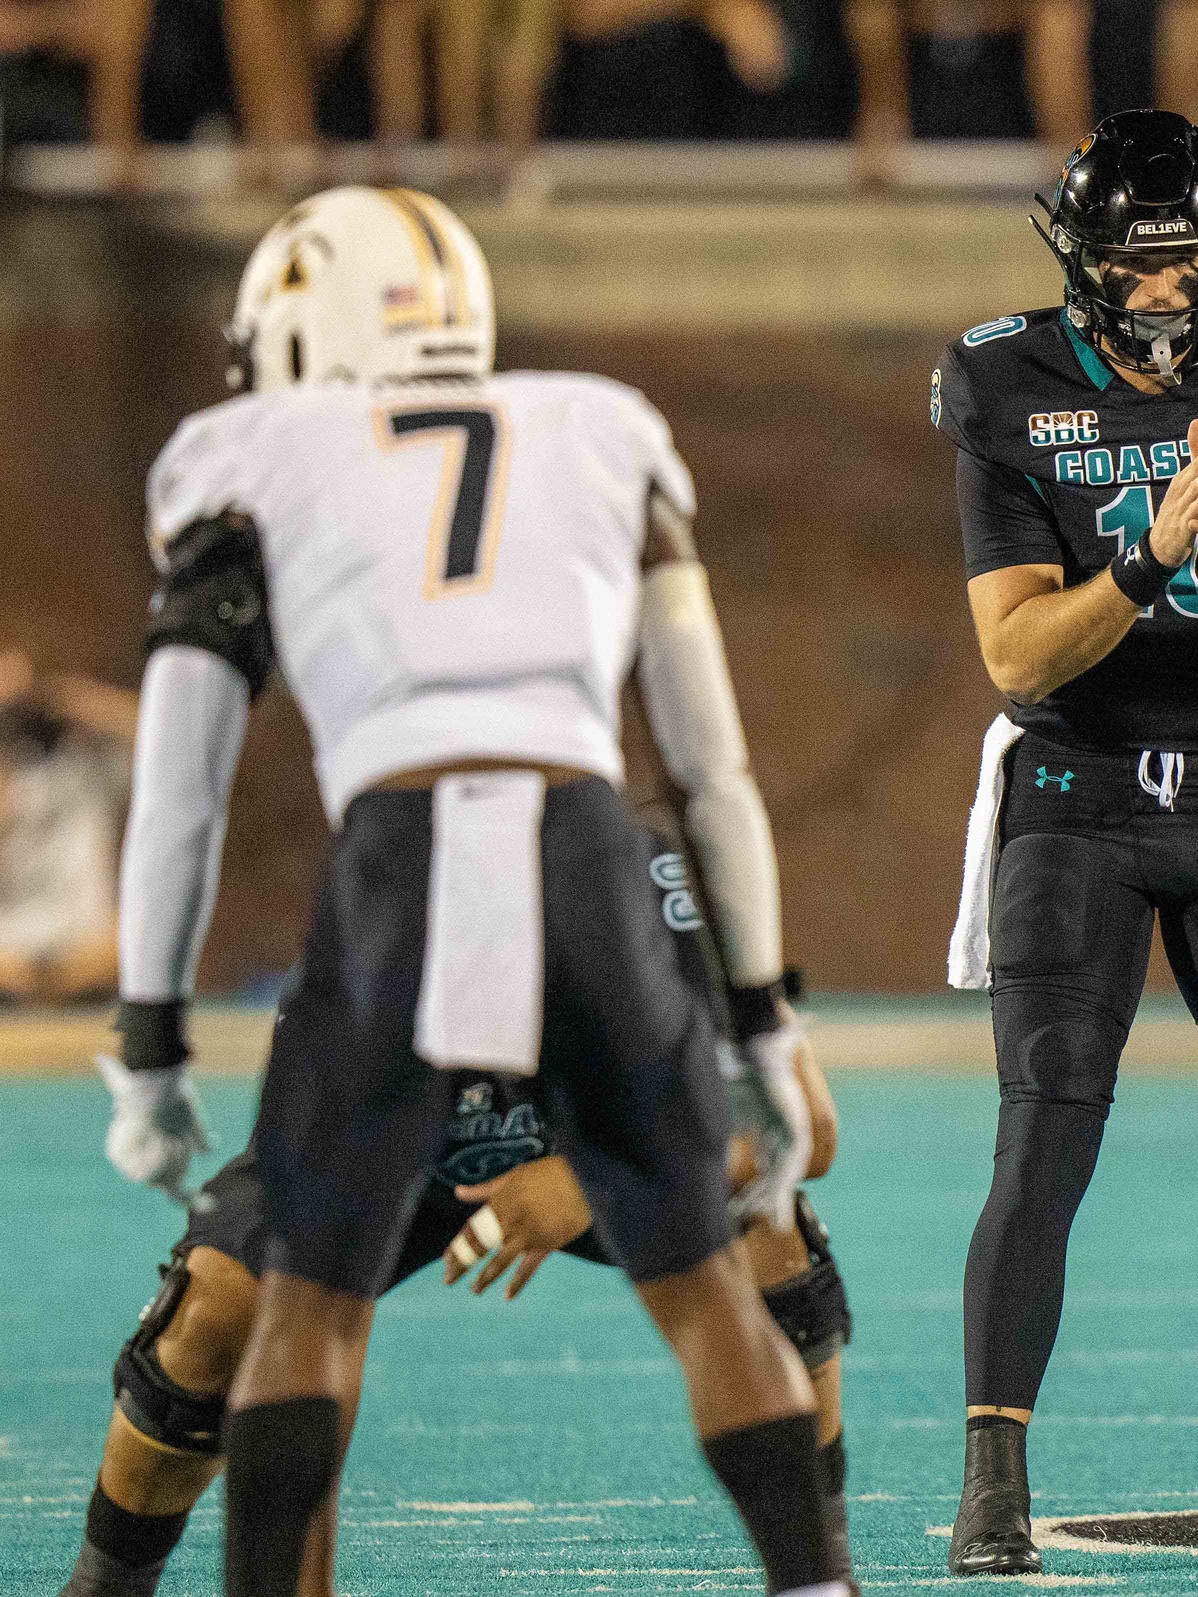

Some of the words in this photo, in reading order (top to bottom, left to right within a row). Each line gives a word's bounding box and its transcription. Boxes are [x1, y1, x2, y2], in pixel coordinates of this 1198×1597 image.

[1137, 222, 1187, 236] BEL1EVE
[961, 316, 1027, 348] 0
[1028, 410, 1100, 447] SBC
[373, 402, 511, 601] 7
